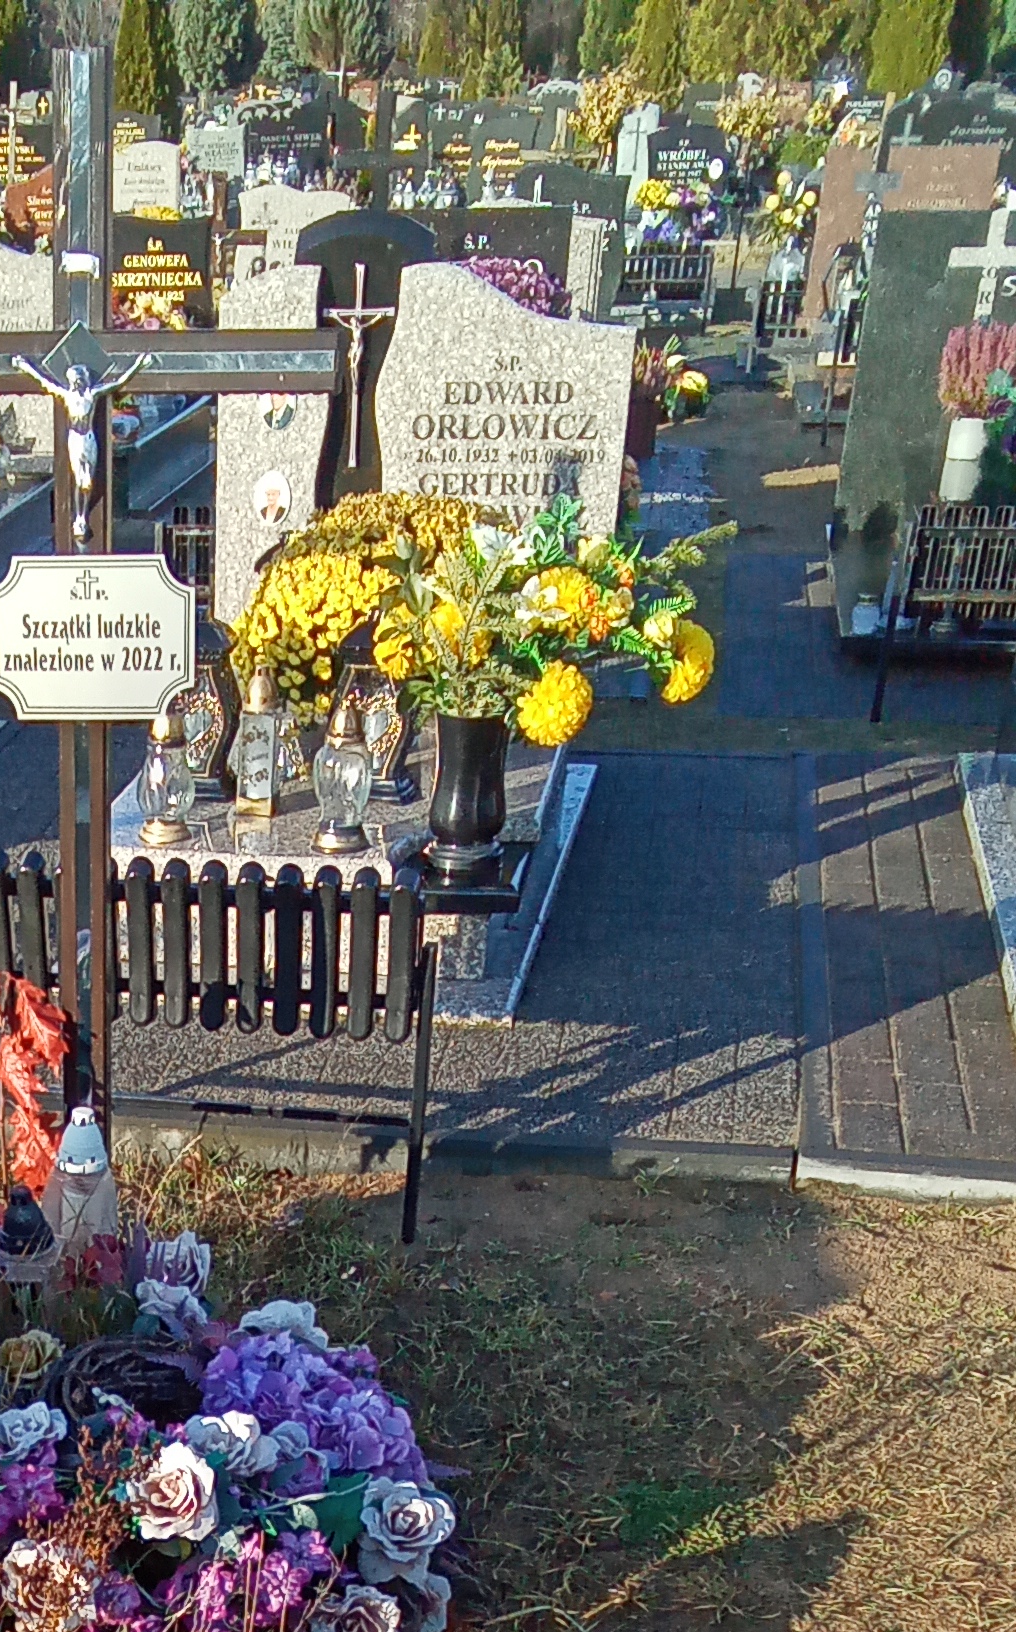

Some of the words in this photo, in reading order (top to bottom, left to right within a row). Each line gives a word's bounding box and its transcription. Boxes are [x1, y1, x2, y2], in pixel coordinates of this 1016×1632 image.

[123, 253, 189, 268] GENOWEFA
[111, 270, 203, 288] SKRZYNIECKA
[444, 381, 575, 405] EDWARD
[411, 413, 599, 441] ORŁOWICZ
[418, 472, 582, 497] GERTRUDA
[22, 613, 91, 646] Szczątki
[97, 613, 161, 639] ludzkie
[4, 647, 94, 672] znalezione
[101, 653, 115, 671] w
[121, 646, 163, 671] 2022
[169, 652, 182, 671] r.
